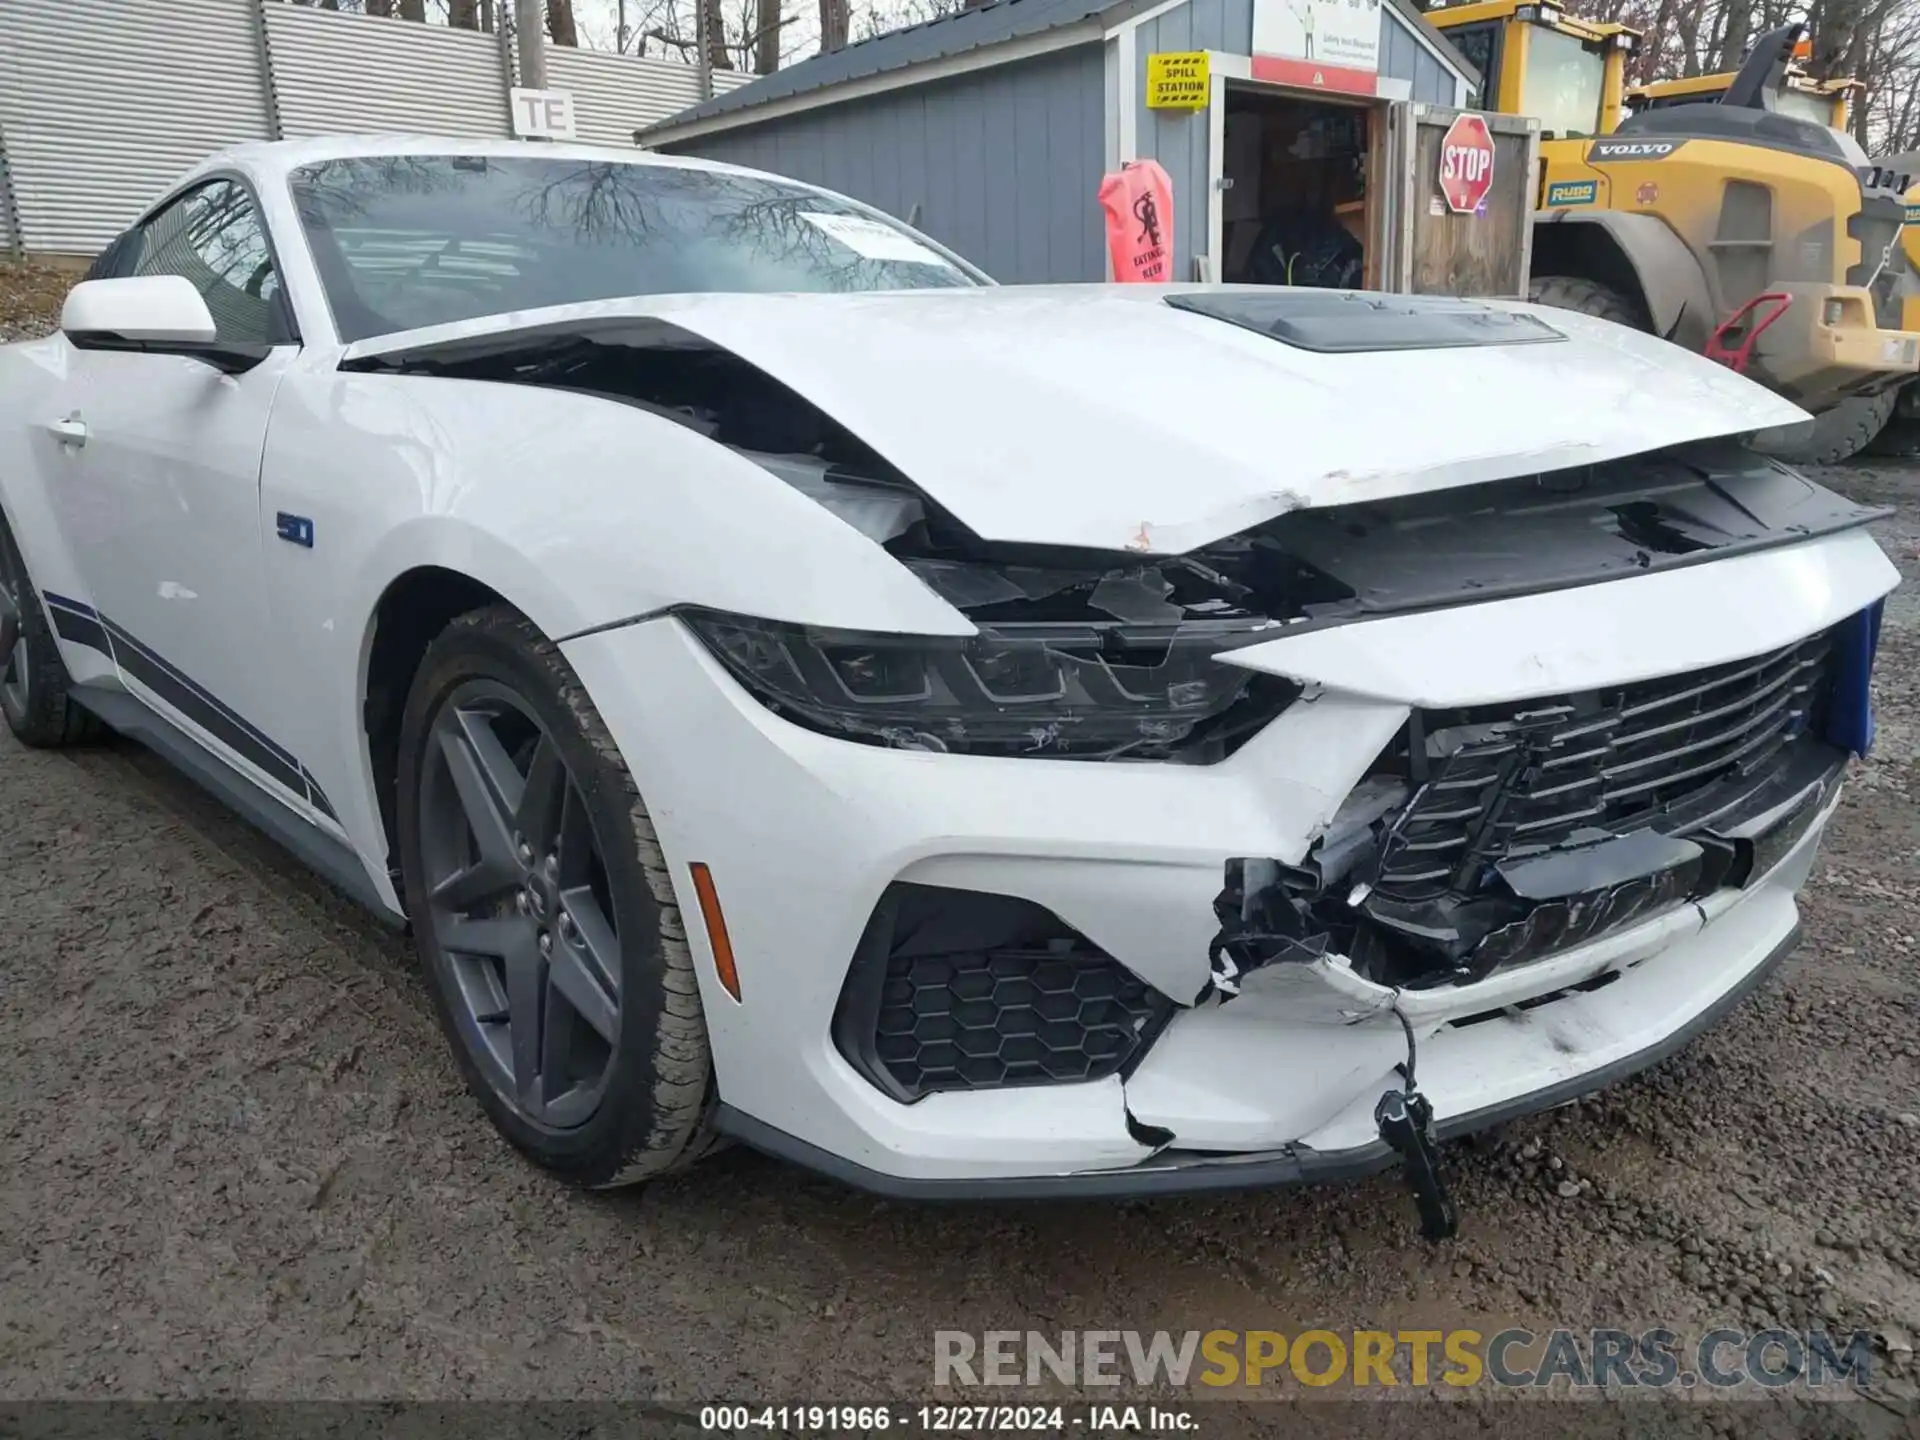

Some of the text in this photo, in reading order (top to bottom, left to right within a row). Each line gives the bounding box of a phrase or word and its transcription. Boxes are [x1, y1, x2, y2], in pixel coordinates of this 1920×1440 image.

[1166, 68, 1197, 78] SPILL
[1157, 80, 1205, 92] STATION
[519, 96, 566, 130] TE
[1599, 143, 1673, 156] VOLVO
[1444, 145, 1490, 182] STOP
